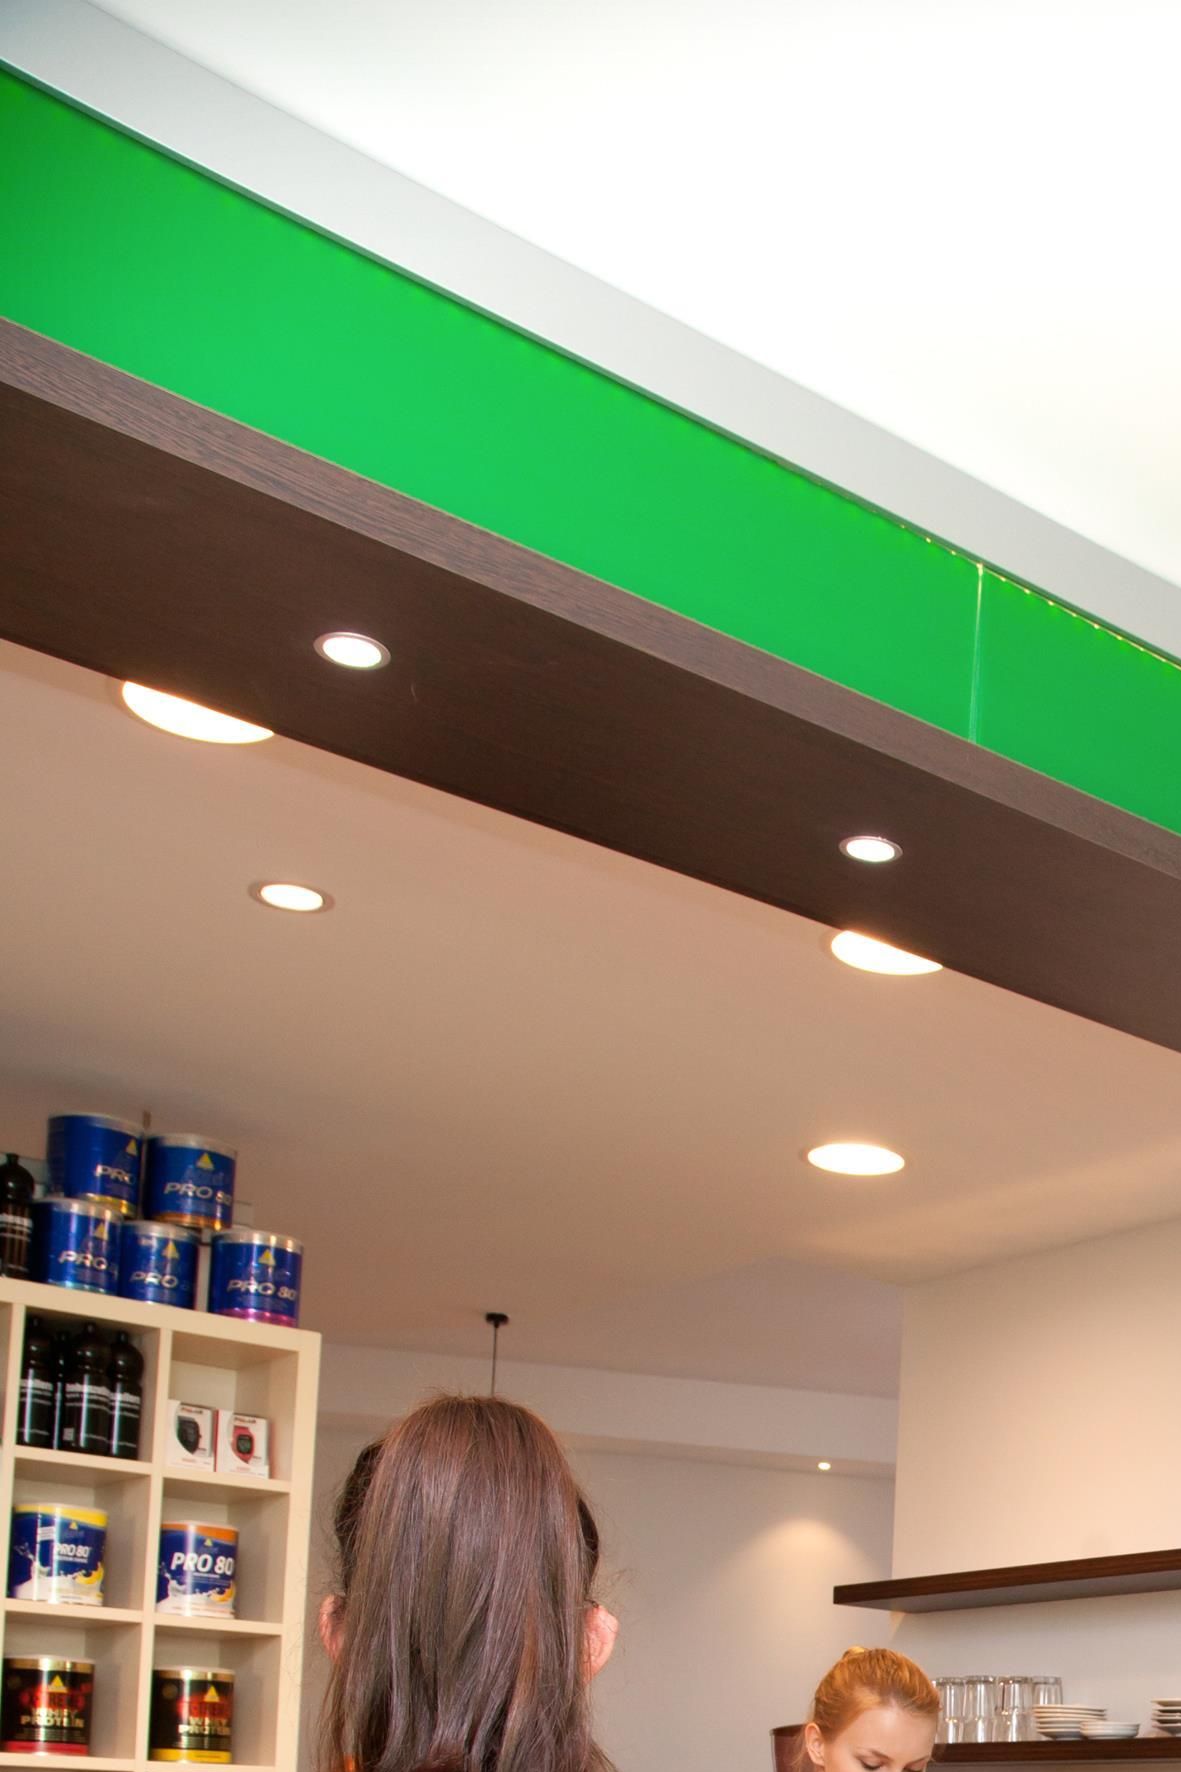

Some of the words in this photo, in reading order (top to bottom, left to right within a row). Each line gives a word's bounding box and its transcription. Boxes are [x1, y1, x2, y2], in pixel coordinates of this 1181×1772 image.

[163, 1182, 213, 1199] PRO
[58, 1250, 108, 1270] PRO
[130, 1271, 178, 1288] PRO
[226, 1279, 276, 1295] PRO
[53, 1543, 76, 1557] PRO
[76, 1544, 90, 1558] 80
[170, 1551, 214, 1573] PRO
[214, 1555, 235, 1576] 80
